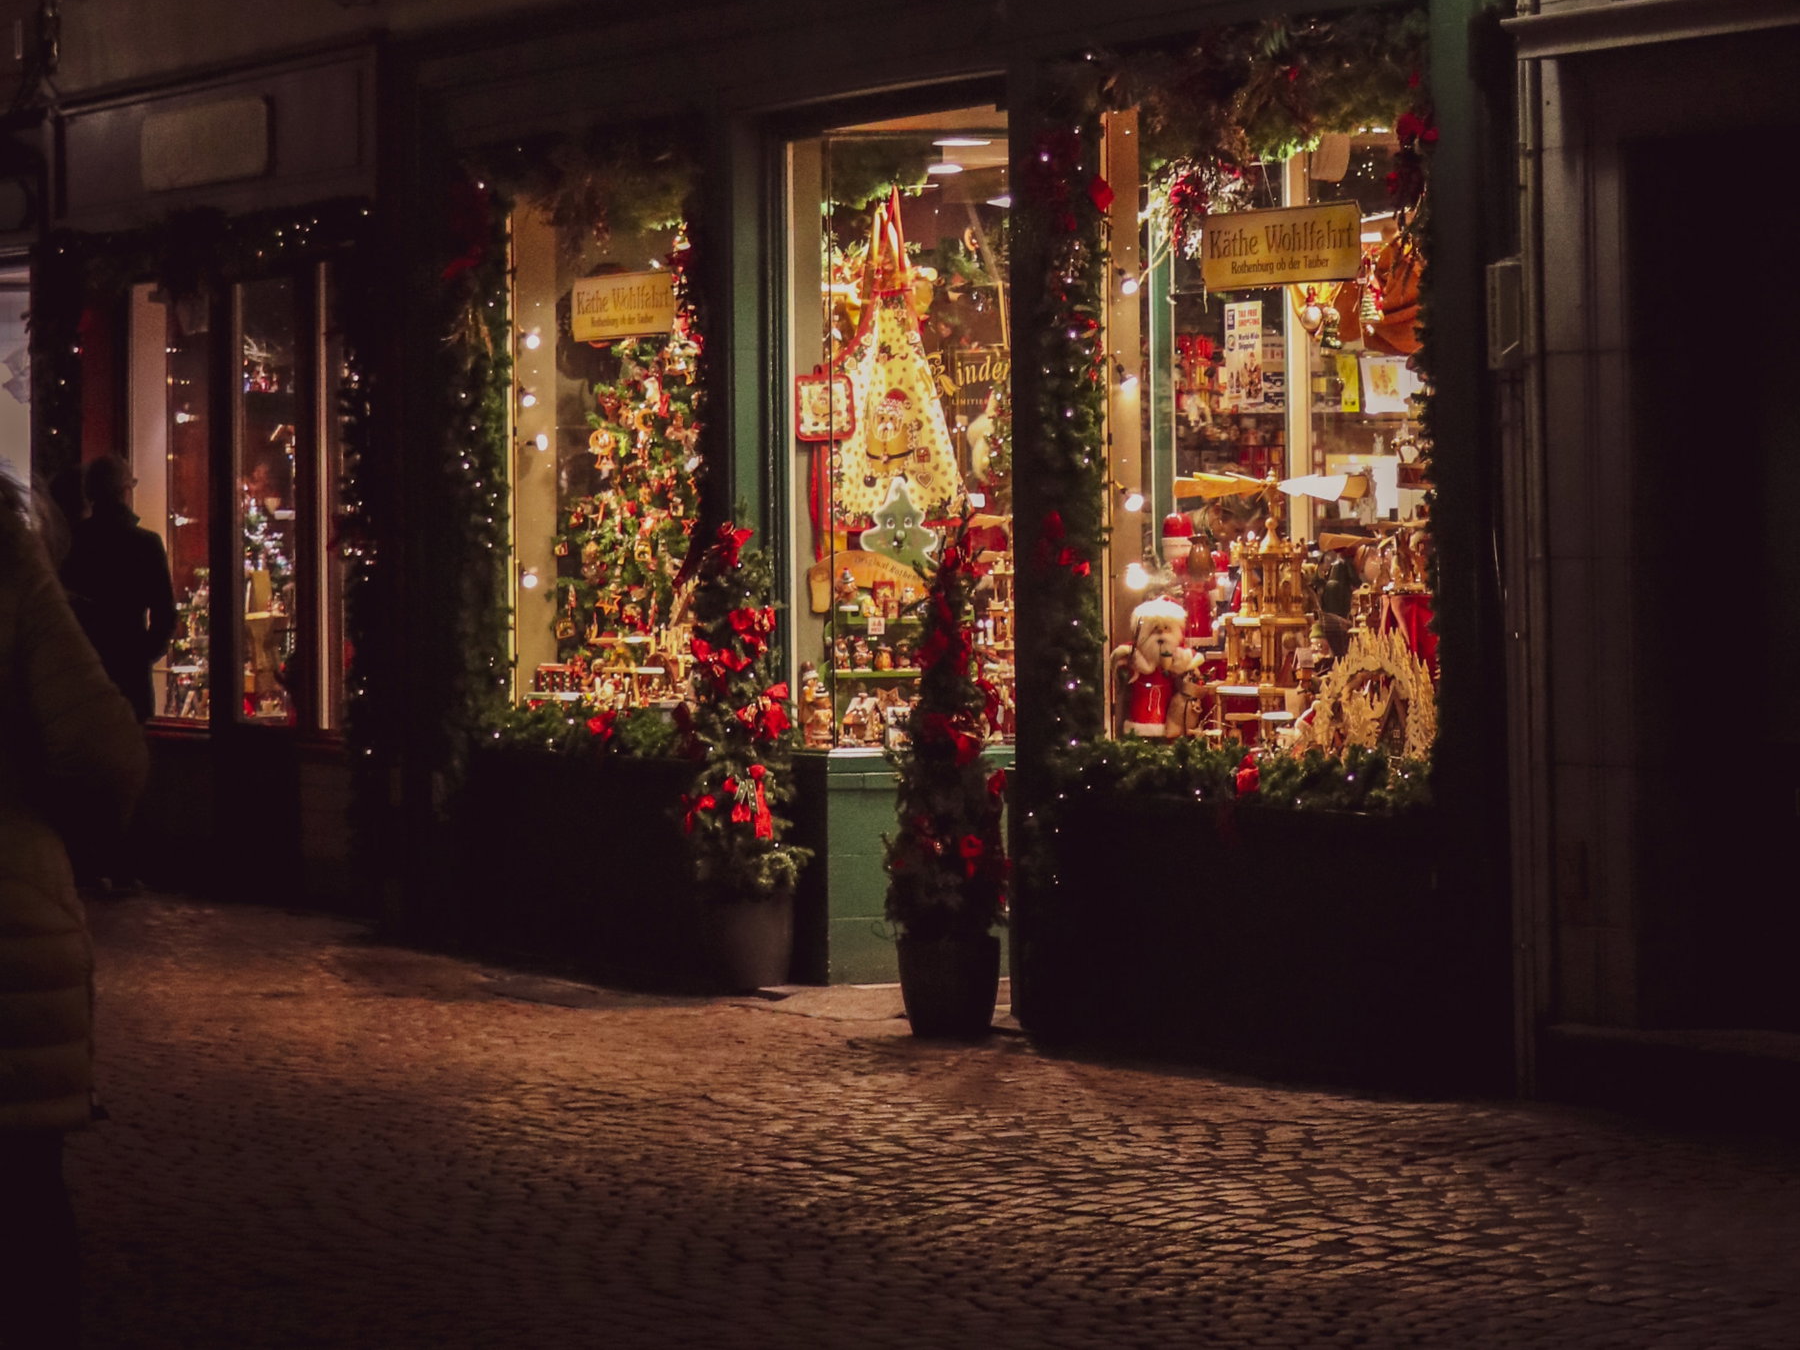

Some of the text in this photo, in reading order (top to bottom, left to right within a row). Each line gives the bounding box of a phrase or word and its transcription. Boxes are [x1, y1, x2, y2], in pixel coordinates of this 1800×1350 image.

[1209, 220, 1355, 259] Käthe Wohlfahrt
[1231, 254, 1329, 275] Rothenburg ob der Tauber
[576, 285, 670, 315] Käthe Wohlfahrt
